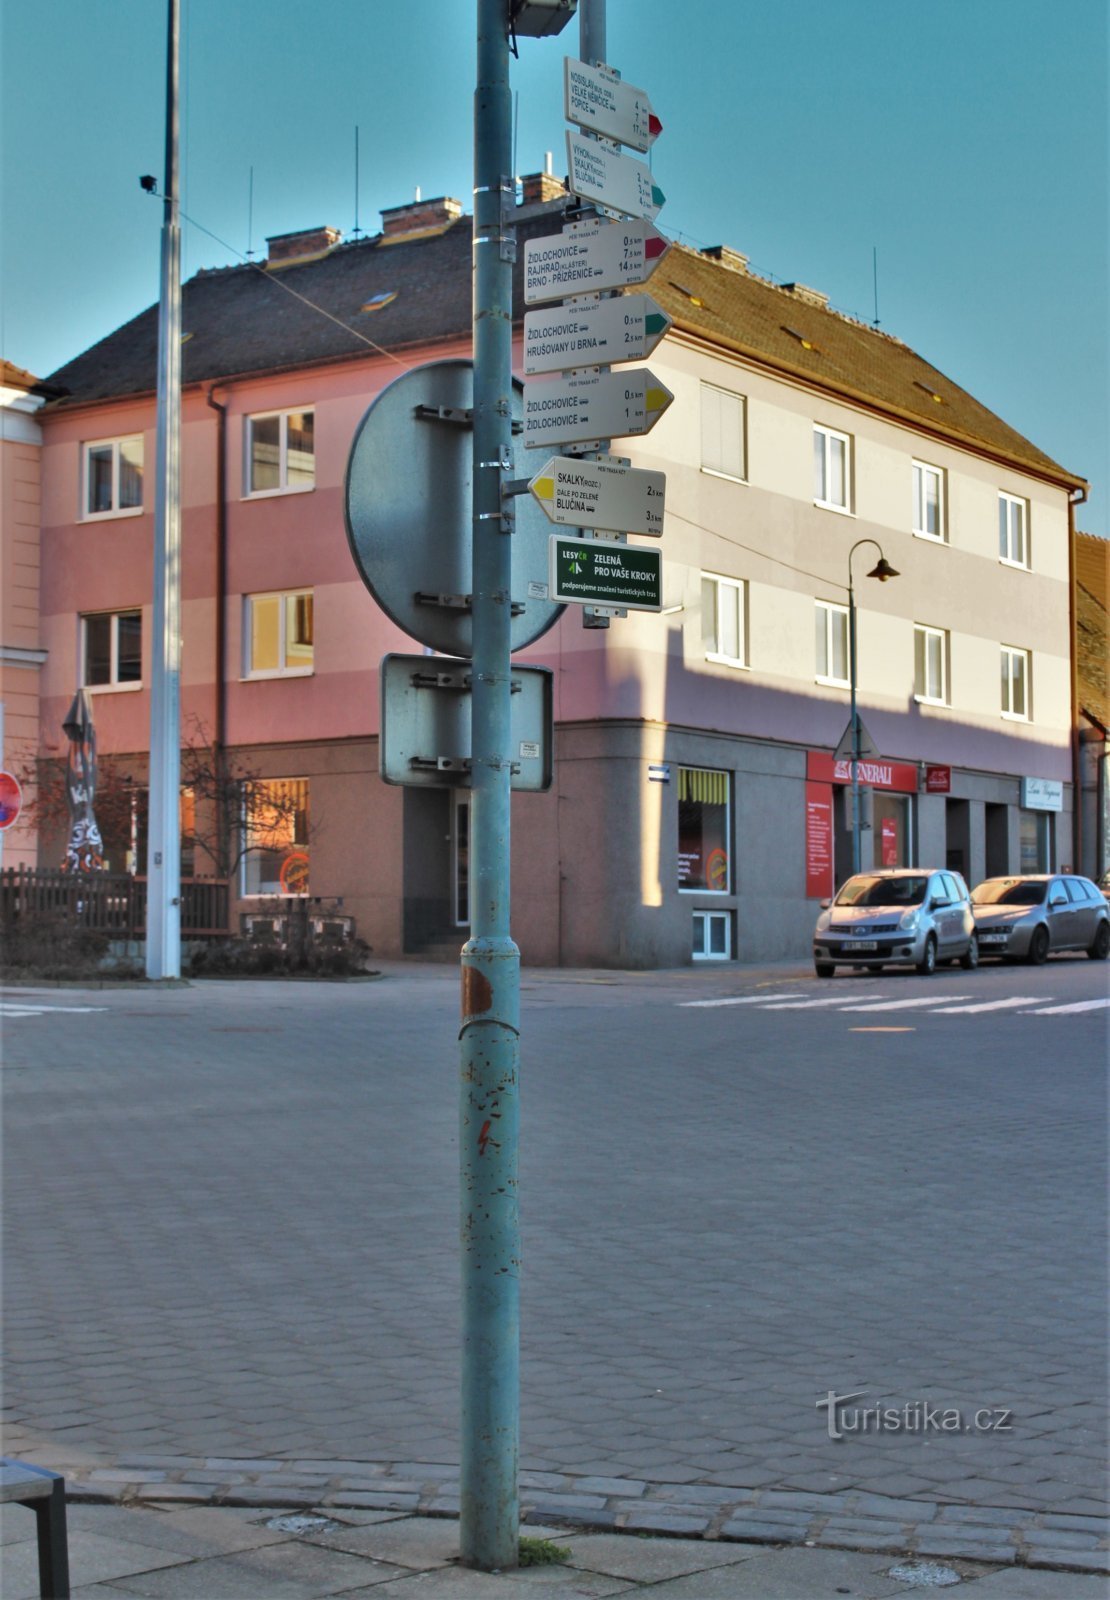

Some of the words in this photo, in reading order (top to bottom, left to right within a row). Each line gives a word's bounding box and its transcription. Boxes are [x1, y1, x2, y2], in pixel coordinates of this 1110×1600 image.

[528, 246, 578, 264] ŽIDLOCHOVICE
[528, 276, 547, 288] BRNO
[528, 323, 578, 340] ŽIDLOCHOVICE
[527, 341, 569, 357] HRUŠOVANY
[571, 341, 575, 350] U
[578, 338, 597, 350] BRNA
[527, 396, 578, 412] ŽIDLOCHOVICE
[625, 408, 629, 418] 1
[527, 414, 578, 430] ŽIDLOCHOVICE
[556, 498, 585, 511] BLUČINA
[594, 554, 622, 566] ZELENÁ
[594, 567, 609, 577] PRO
[611, 567, 629, 579] VAŠE
[631, 570, 656, 582] KROKY
[562, 581, 596, 592] podporujeme
[597, 585, 617, 593] značení
[618, 587, 646, 597] turistických
[647, 590, 656, 598] tras
